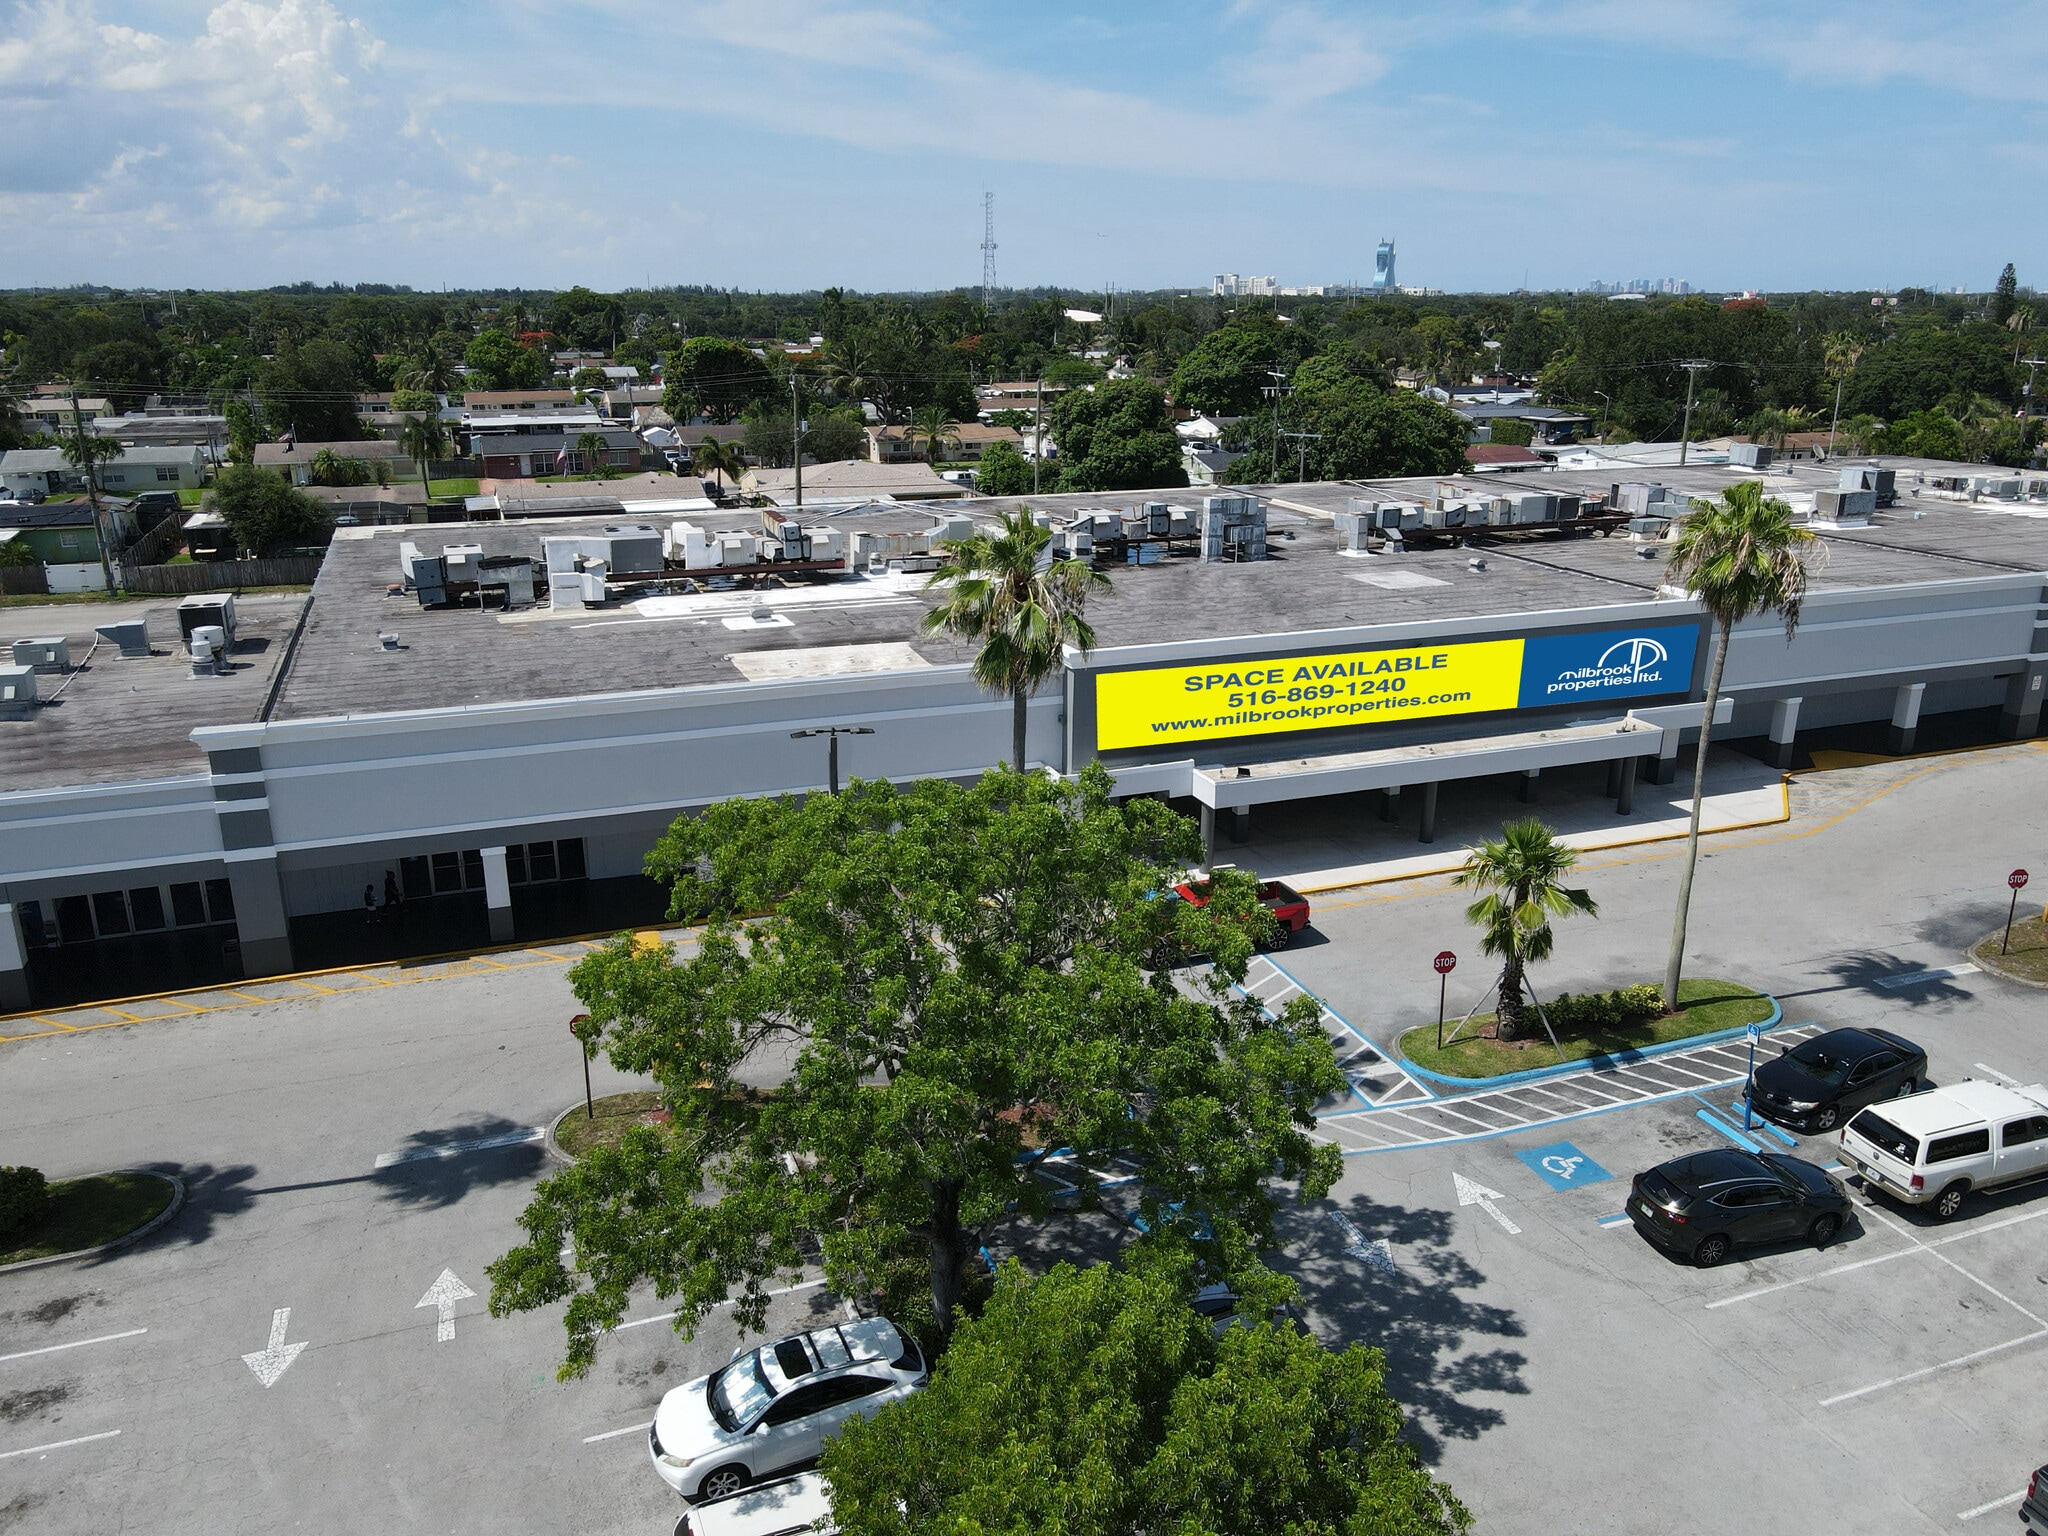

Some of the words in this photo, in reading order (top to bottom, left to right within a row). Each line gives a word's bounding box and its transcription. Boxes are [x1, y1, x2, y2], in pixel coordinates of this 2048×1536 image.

[1184, 668, 1284, 692] SPACE
[1292, 653, 1449, 682] AVAILABLE
[1546, 675, 1632, 694] properties
[1638, 671, 1663, 683] ltd.
[1557, 663, 1633, 681] milbrook
[1228, 677, 1406, 708] 516-869-1240
[1151, 691, 1471, 733] www.milbrookproperties.com
[2009, 874, 2028, 884] STOP
[1435, 957, 1456, 968] STOP
